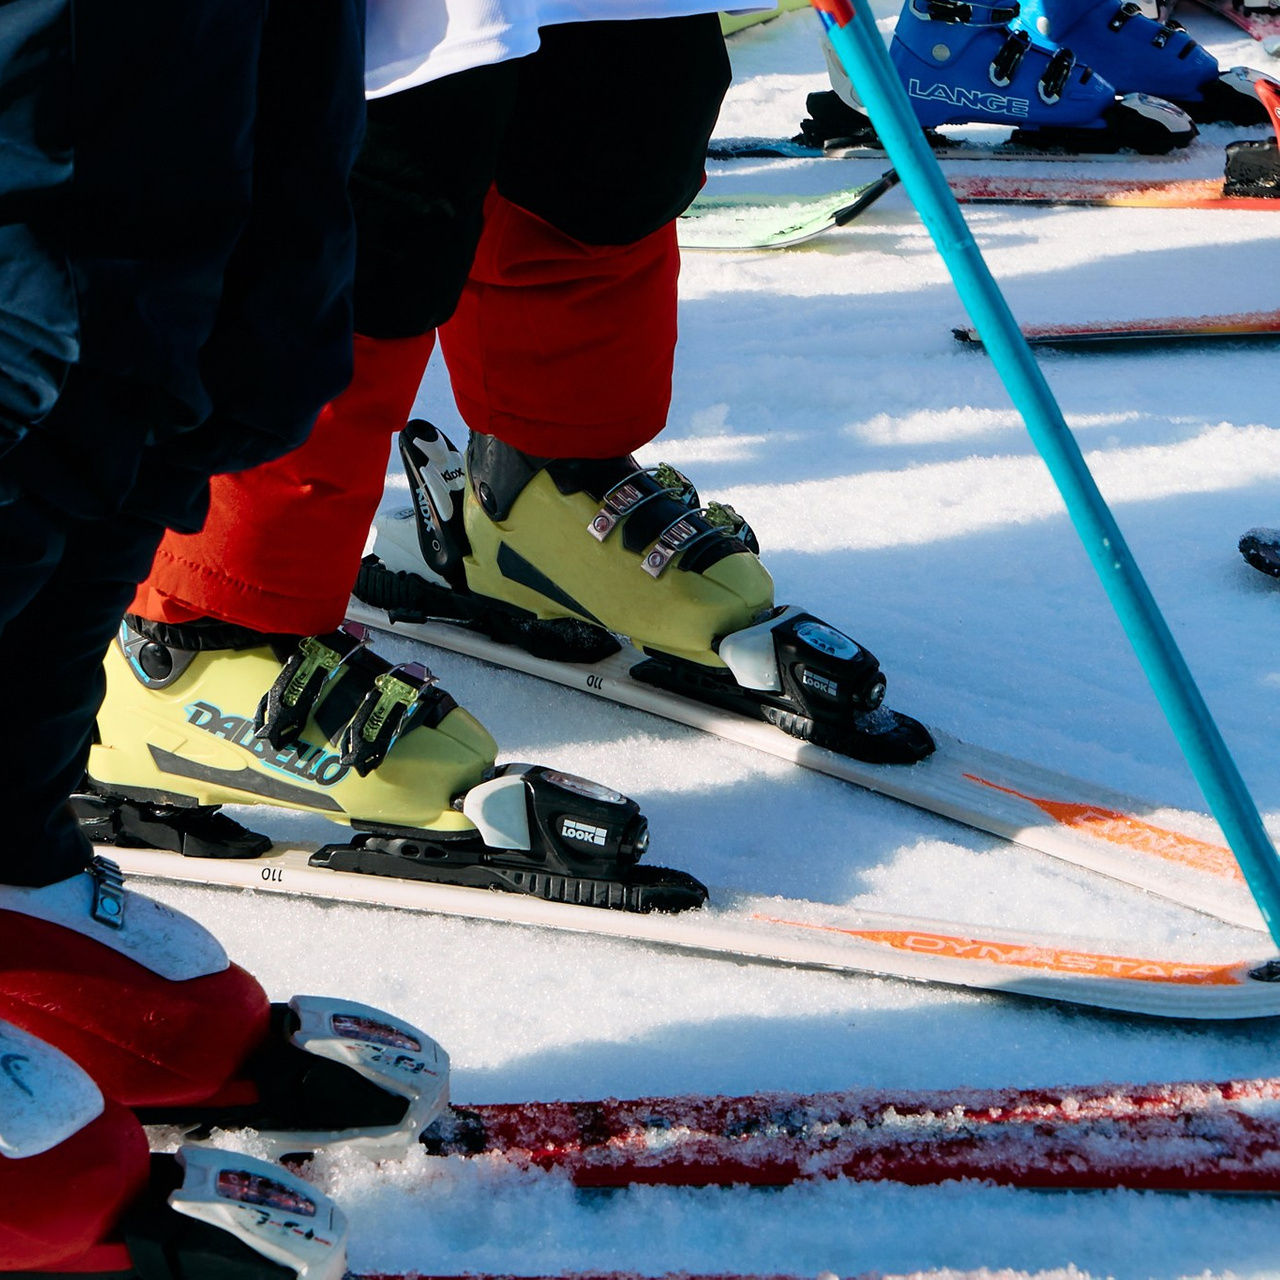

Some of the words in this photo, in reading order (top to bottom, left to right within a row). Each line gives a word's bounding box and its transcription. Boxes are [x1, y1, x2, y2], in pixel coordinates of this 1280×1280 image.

[909, 79, 1029, 117] LANGE
[803, 675, 827, 693] LOOK
[562, 826, 595, 843] LOOK
